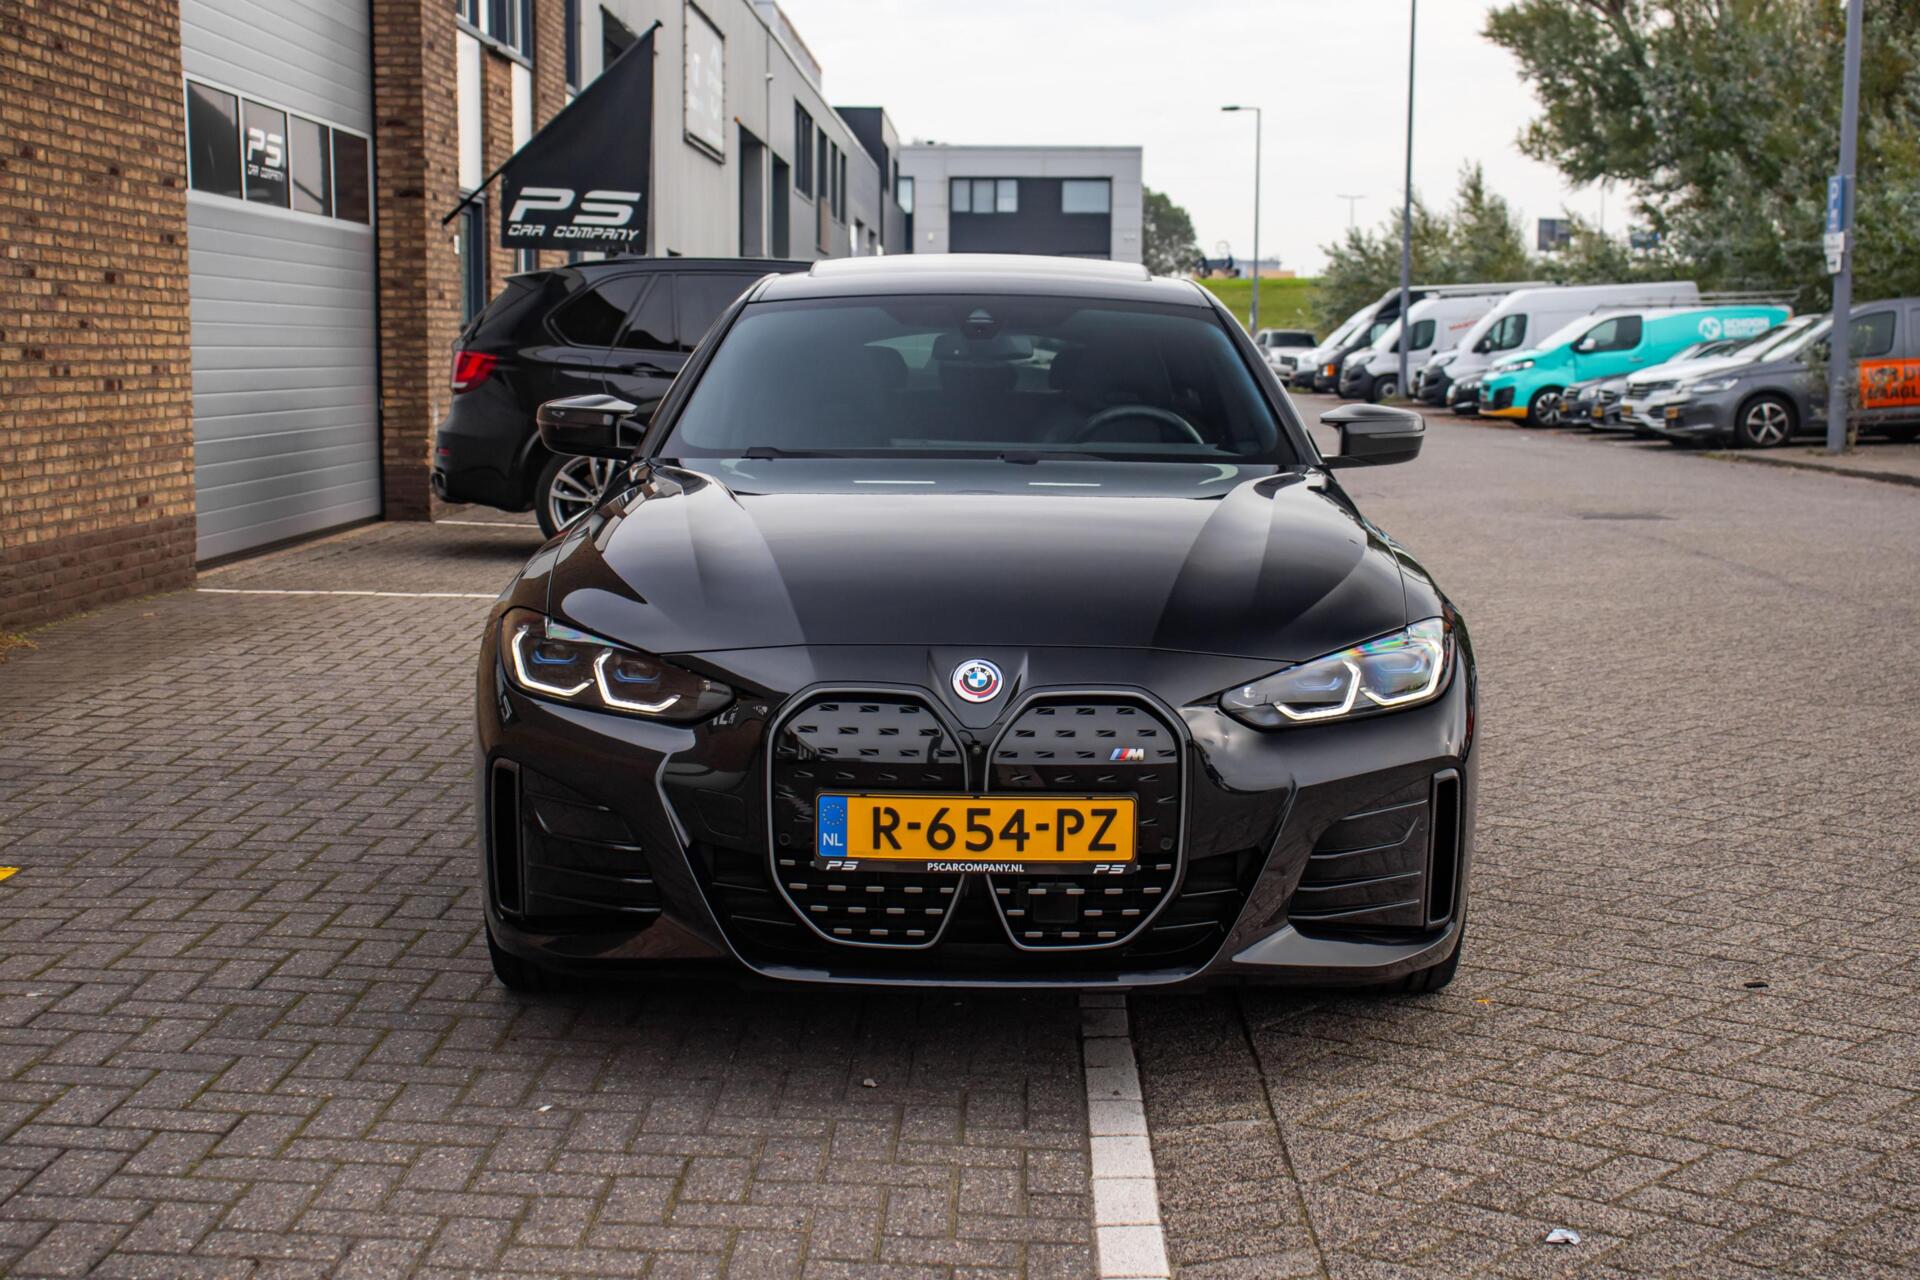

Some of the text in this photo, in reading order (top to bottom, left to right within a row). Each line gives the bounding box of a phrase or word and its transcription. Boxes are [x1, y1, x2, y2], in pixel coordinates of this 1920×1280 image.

[247, 127, 283, 168] PS
[508, 186, 642, 226] PS
[508, 223, 639, 241] CAR COMPANY
[964, 666, 991, 676] BMW
[872, 806, 1118, 852] R-654-PZ
[822, 832, 844, 847] NL
[826, 860, 1126, 875] PS PSCARCOMPANY.NL PS
